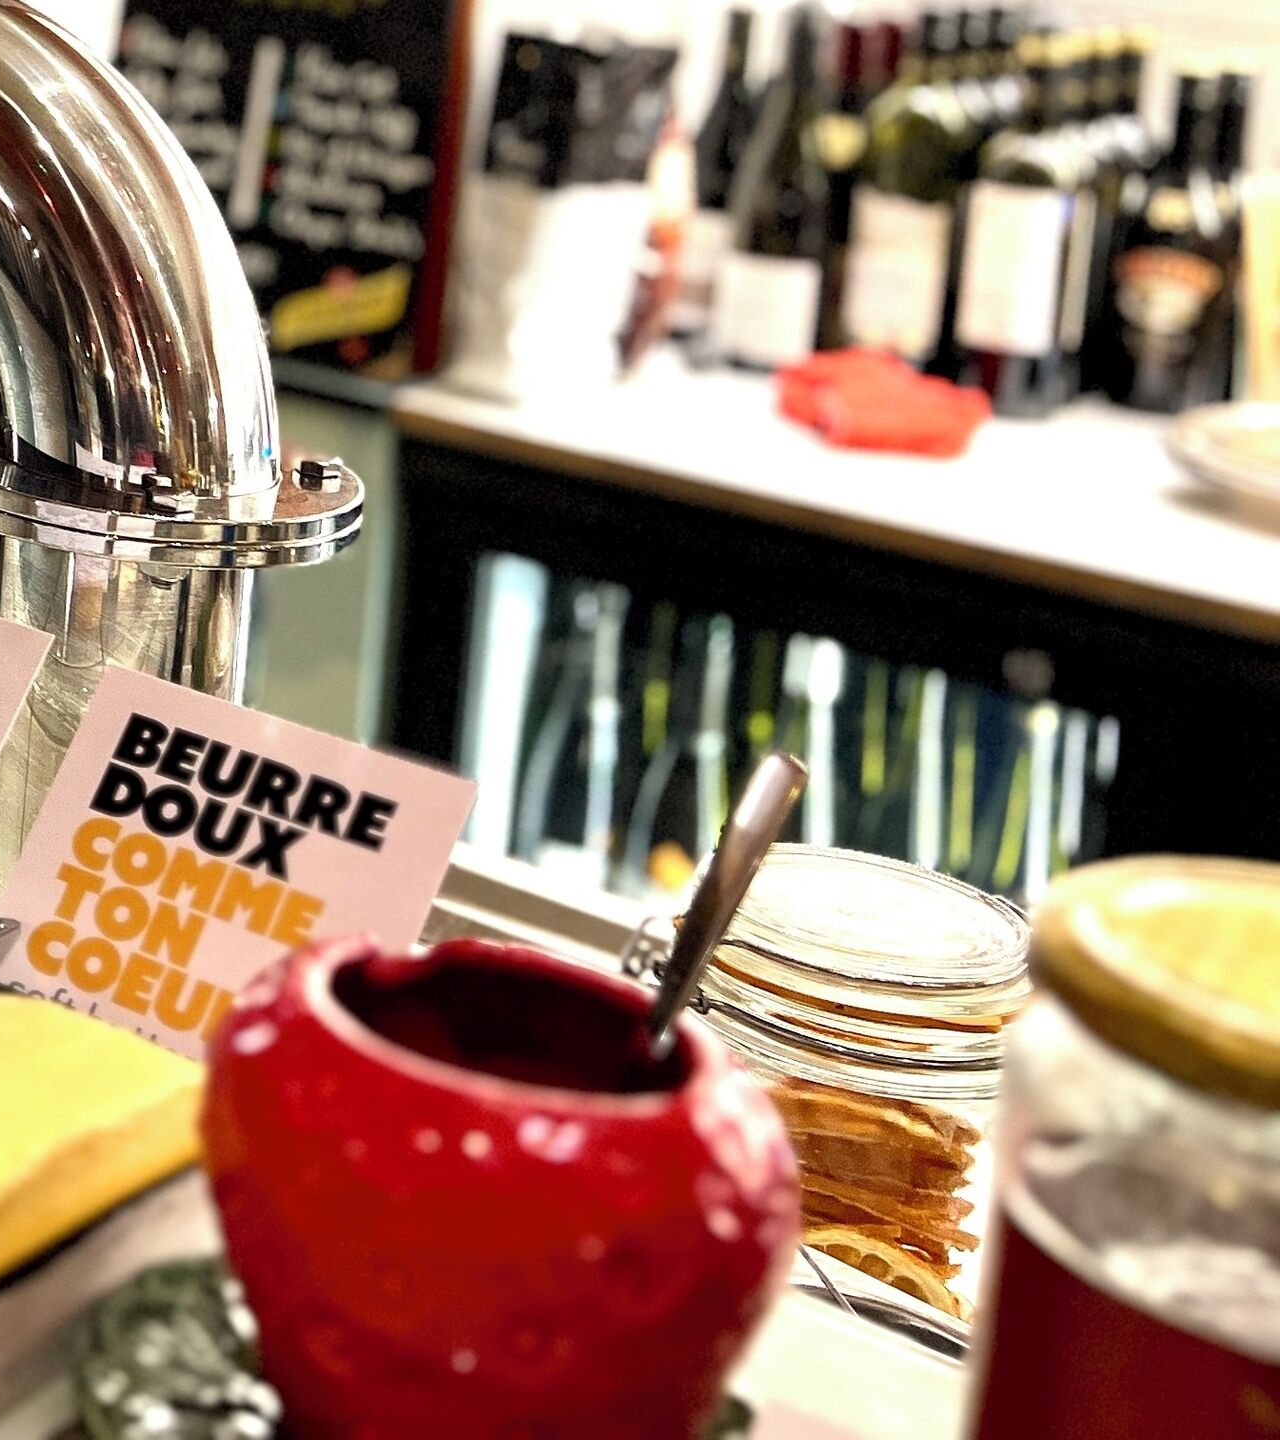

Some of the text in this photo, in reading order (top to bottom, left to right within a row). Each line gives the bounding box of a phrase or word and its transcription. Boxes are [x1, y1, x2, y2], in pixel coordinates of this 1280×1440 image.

[89, 762, 308, 880] DOUX
[112, 712, 399, 853] BEURRE
[56, 862, 207, 968] TON
[72, 817, 326, 947] COMME
